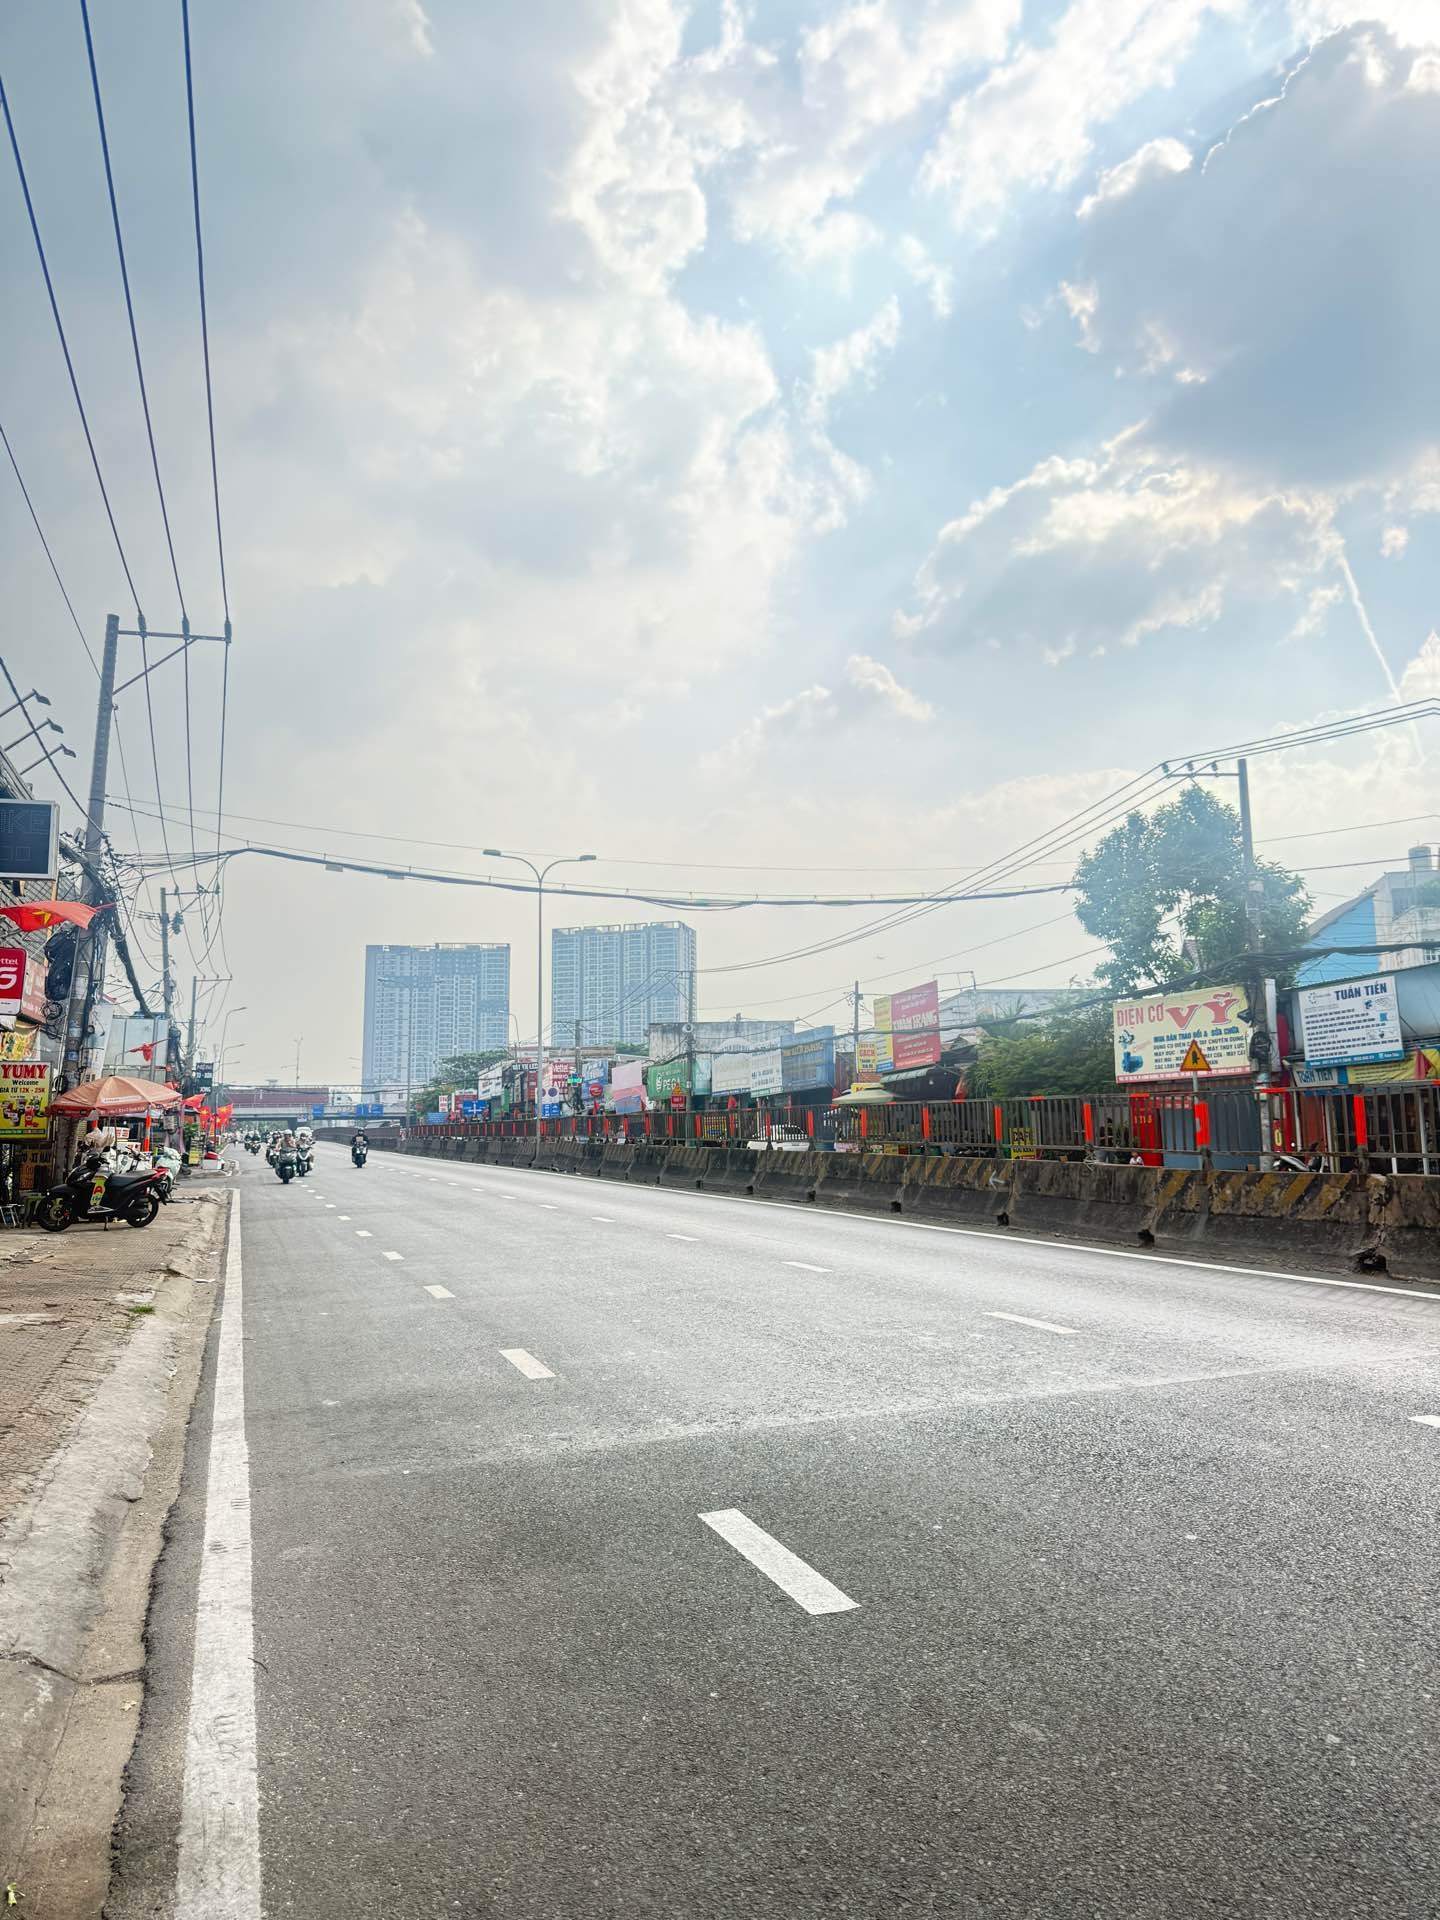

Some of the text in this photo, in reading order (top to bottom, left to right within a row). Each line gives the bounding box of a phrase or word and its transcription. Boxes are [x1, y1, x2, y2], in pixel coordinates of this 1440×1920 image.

[1117, 1005, 1144, 1029] ĐIỆN
[1148, 1003, 1164, 1024] CƠ
[1, 1064, 49, 1079] YUMY
